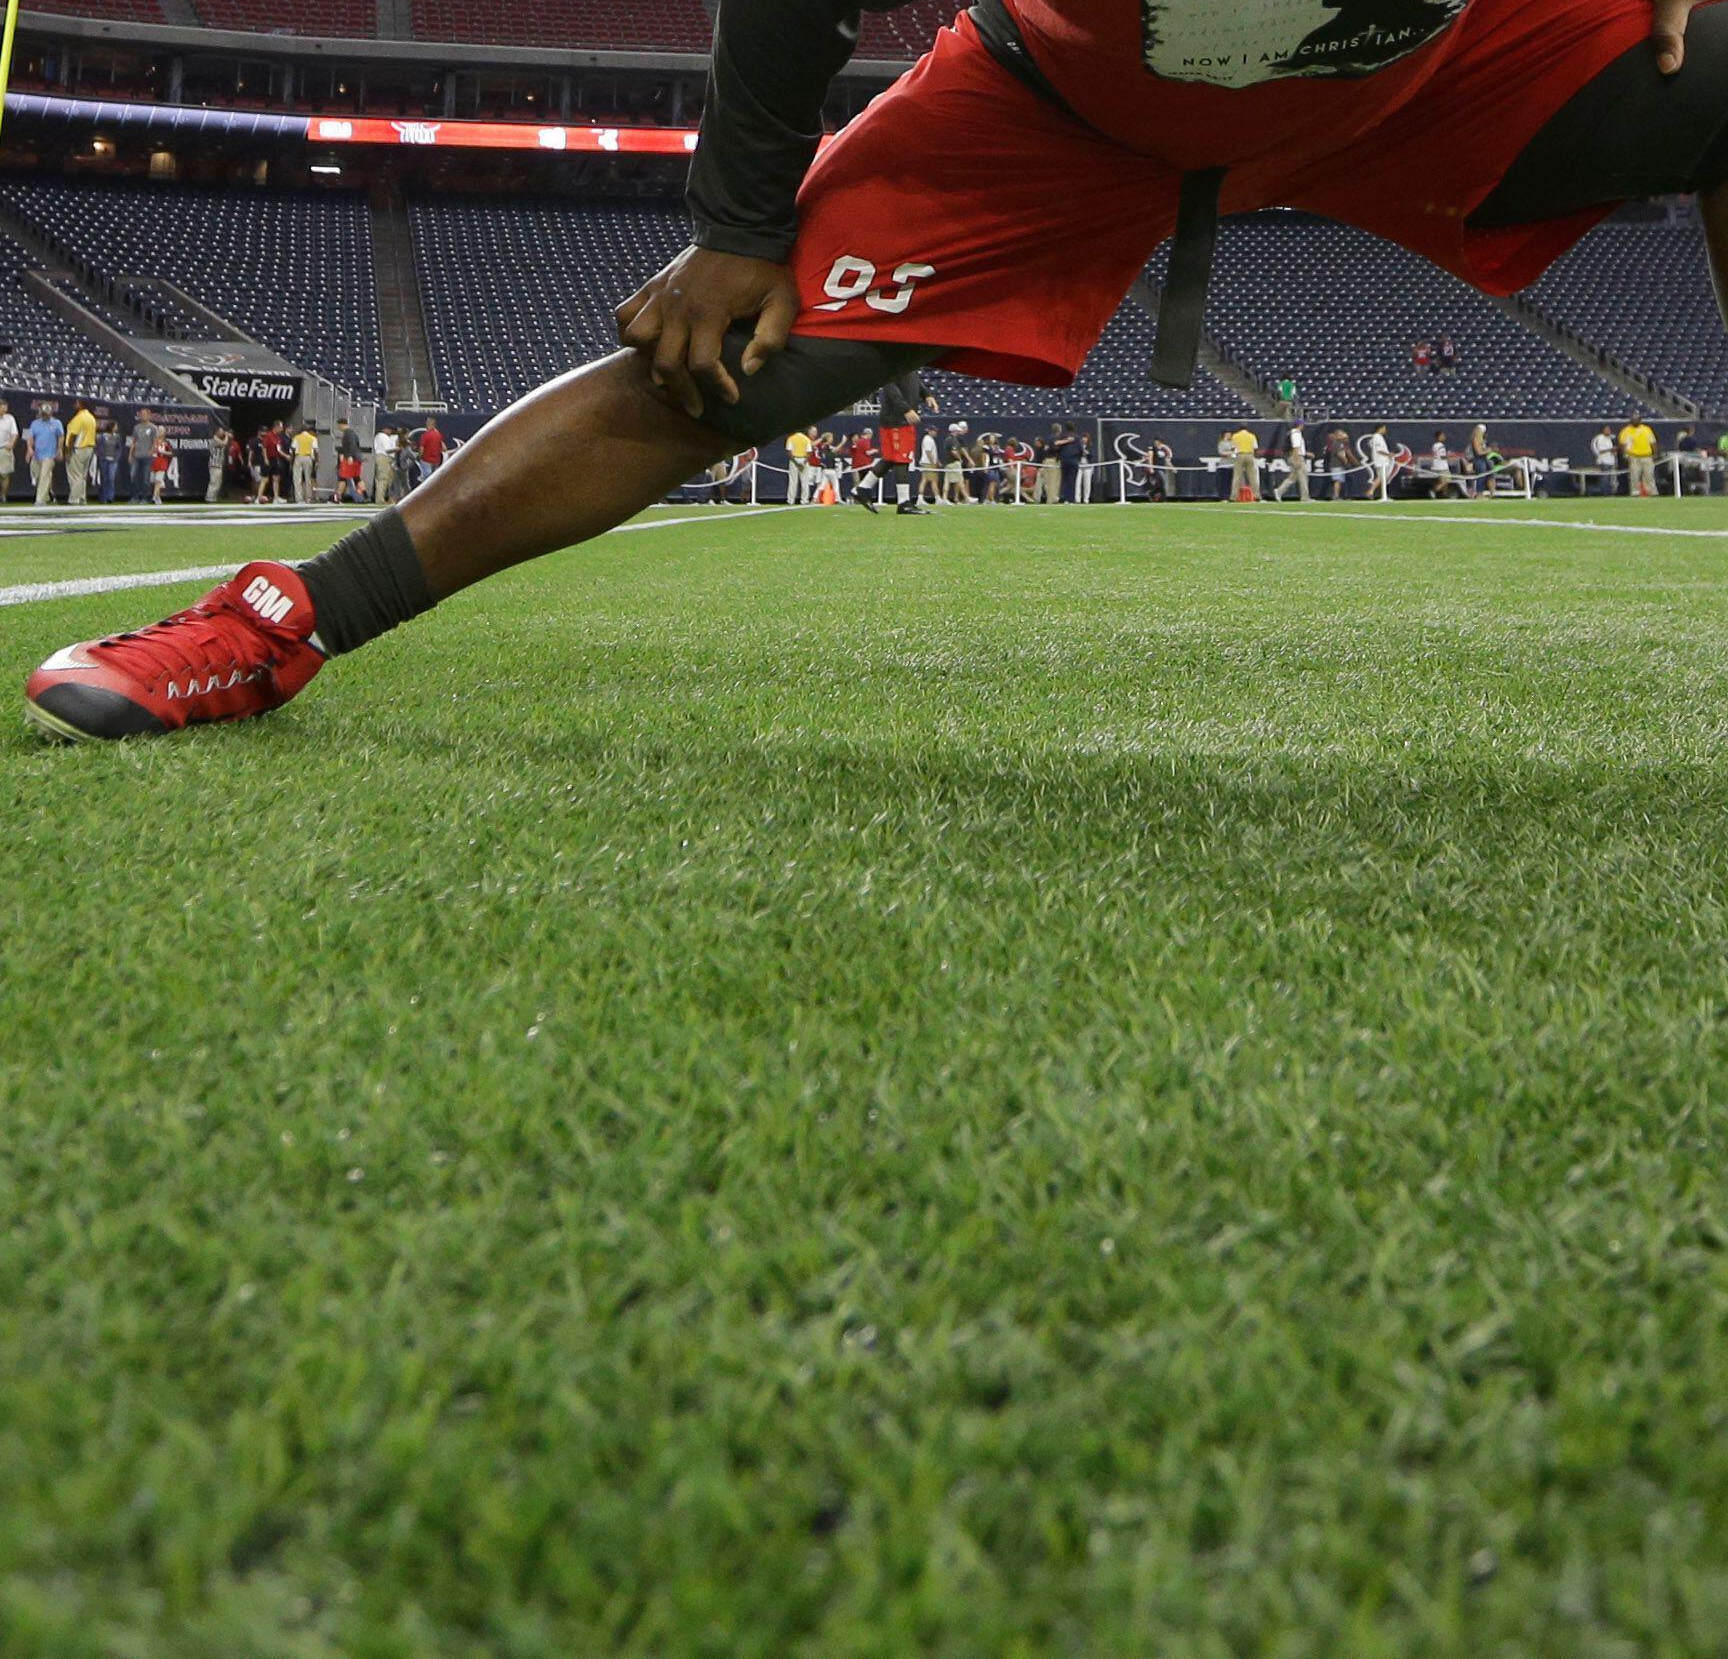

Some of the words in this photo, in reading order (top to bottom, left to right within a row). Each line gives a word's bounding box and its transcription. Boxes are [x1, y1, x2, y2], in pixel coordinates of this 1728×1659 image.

[1182, 55, 1231, 67] NOW
[1259, 49, 1289, 63] AM
[242, 575, 295, 624] GM
